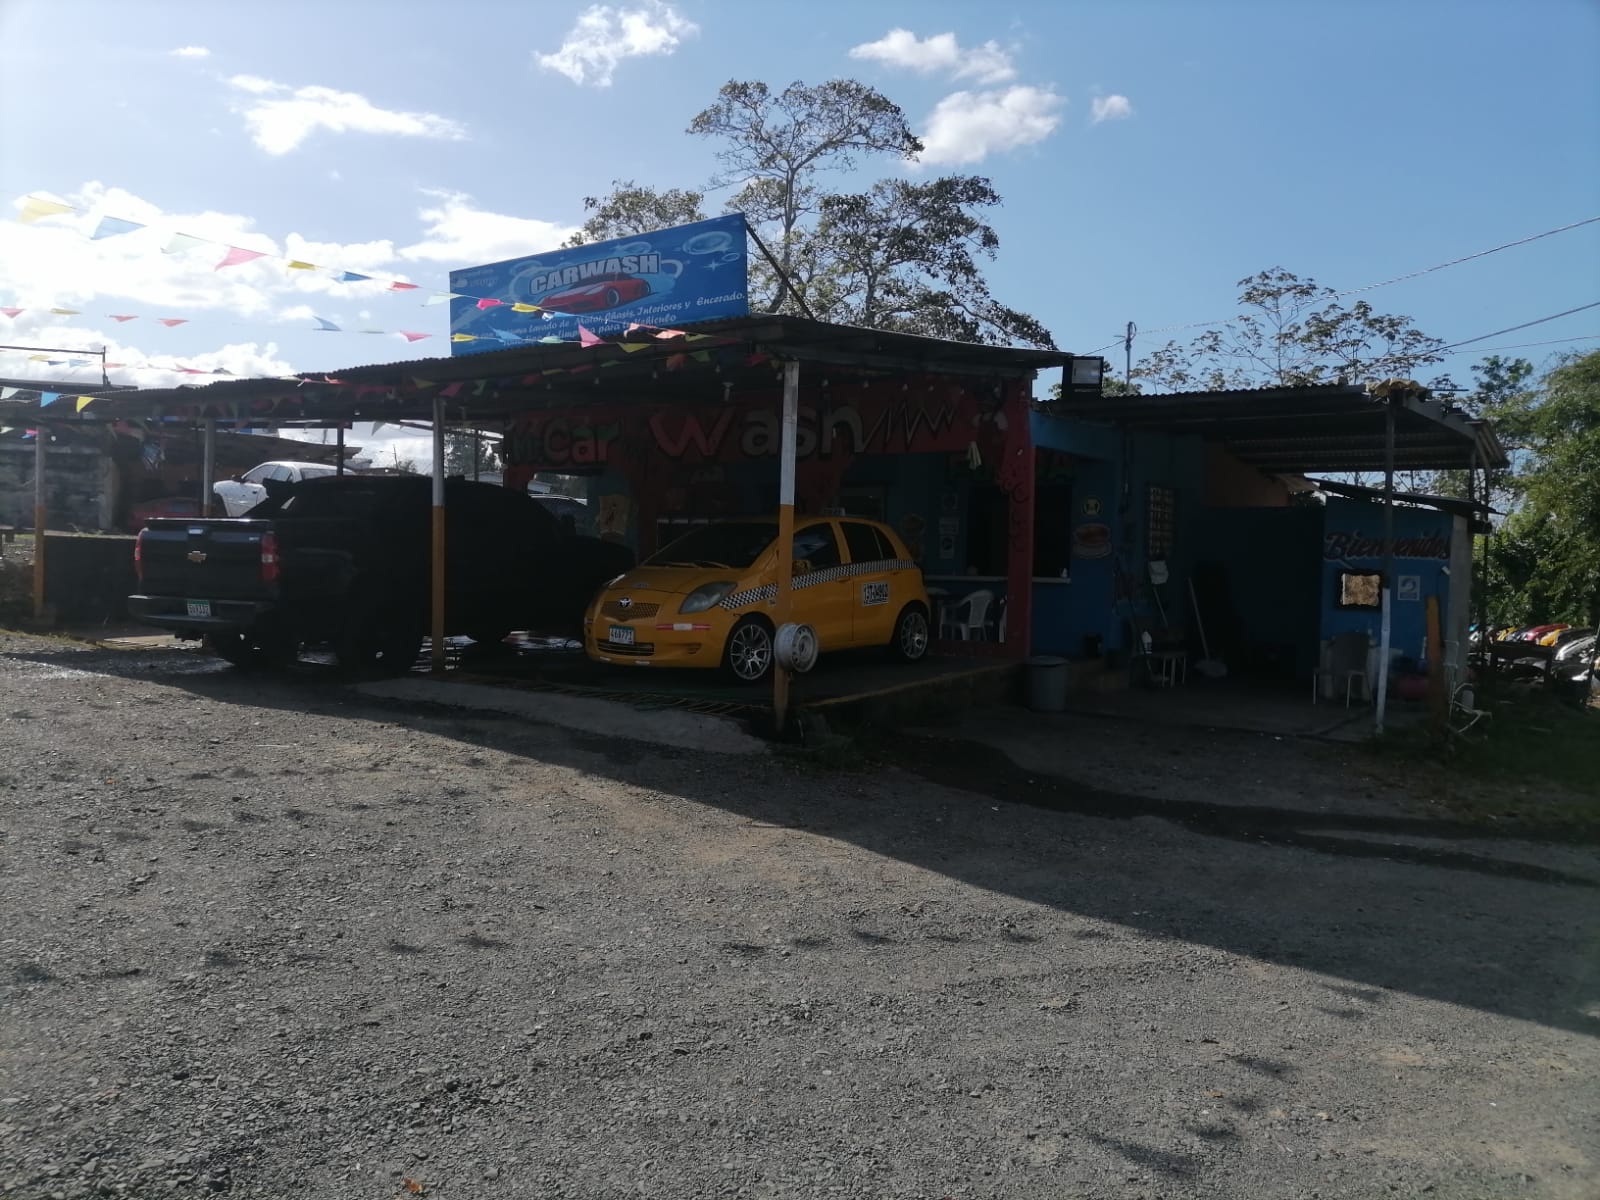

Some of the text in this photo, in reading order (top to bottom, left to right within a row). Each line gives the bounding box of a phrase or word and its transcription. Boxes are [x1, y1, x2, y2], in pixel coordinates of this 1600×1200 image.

[530, 253, 658, 294] CARWASH
[637, 303, 682, 316] Interiores
[684, 301, 692, 311] y
[544, 416, 622, 464] Car
